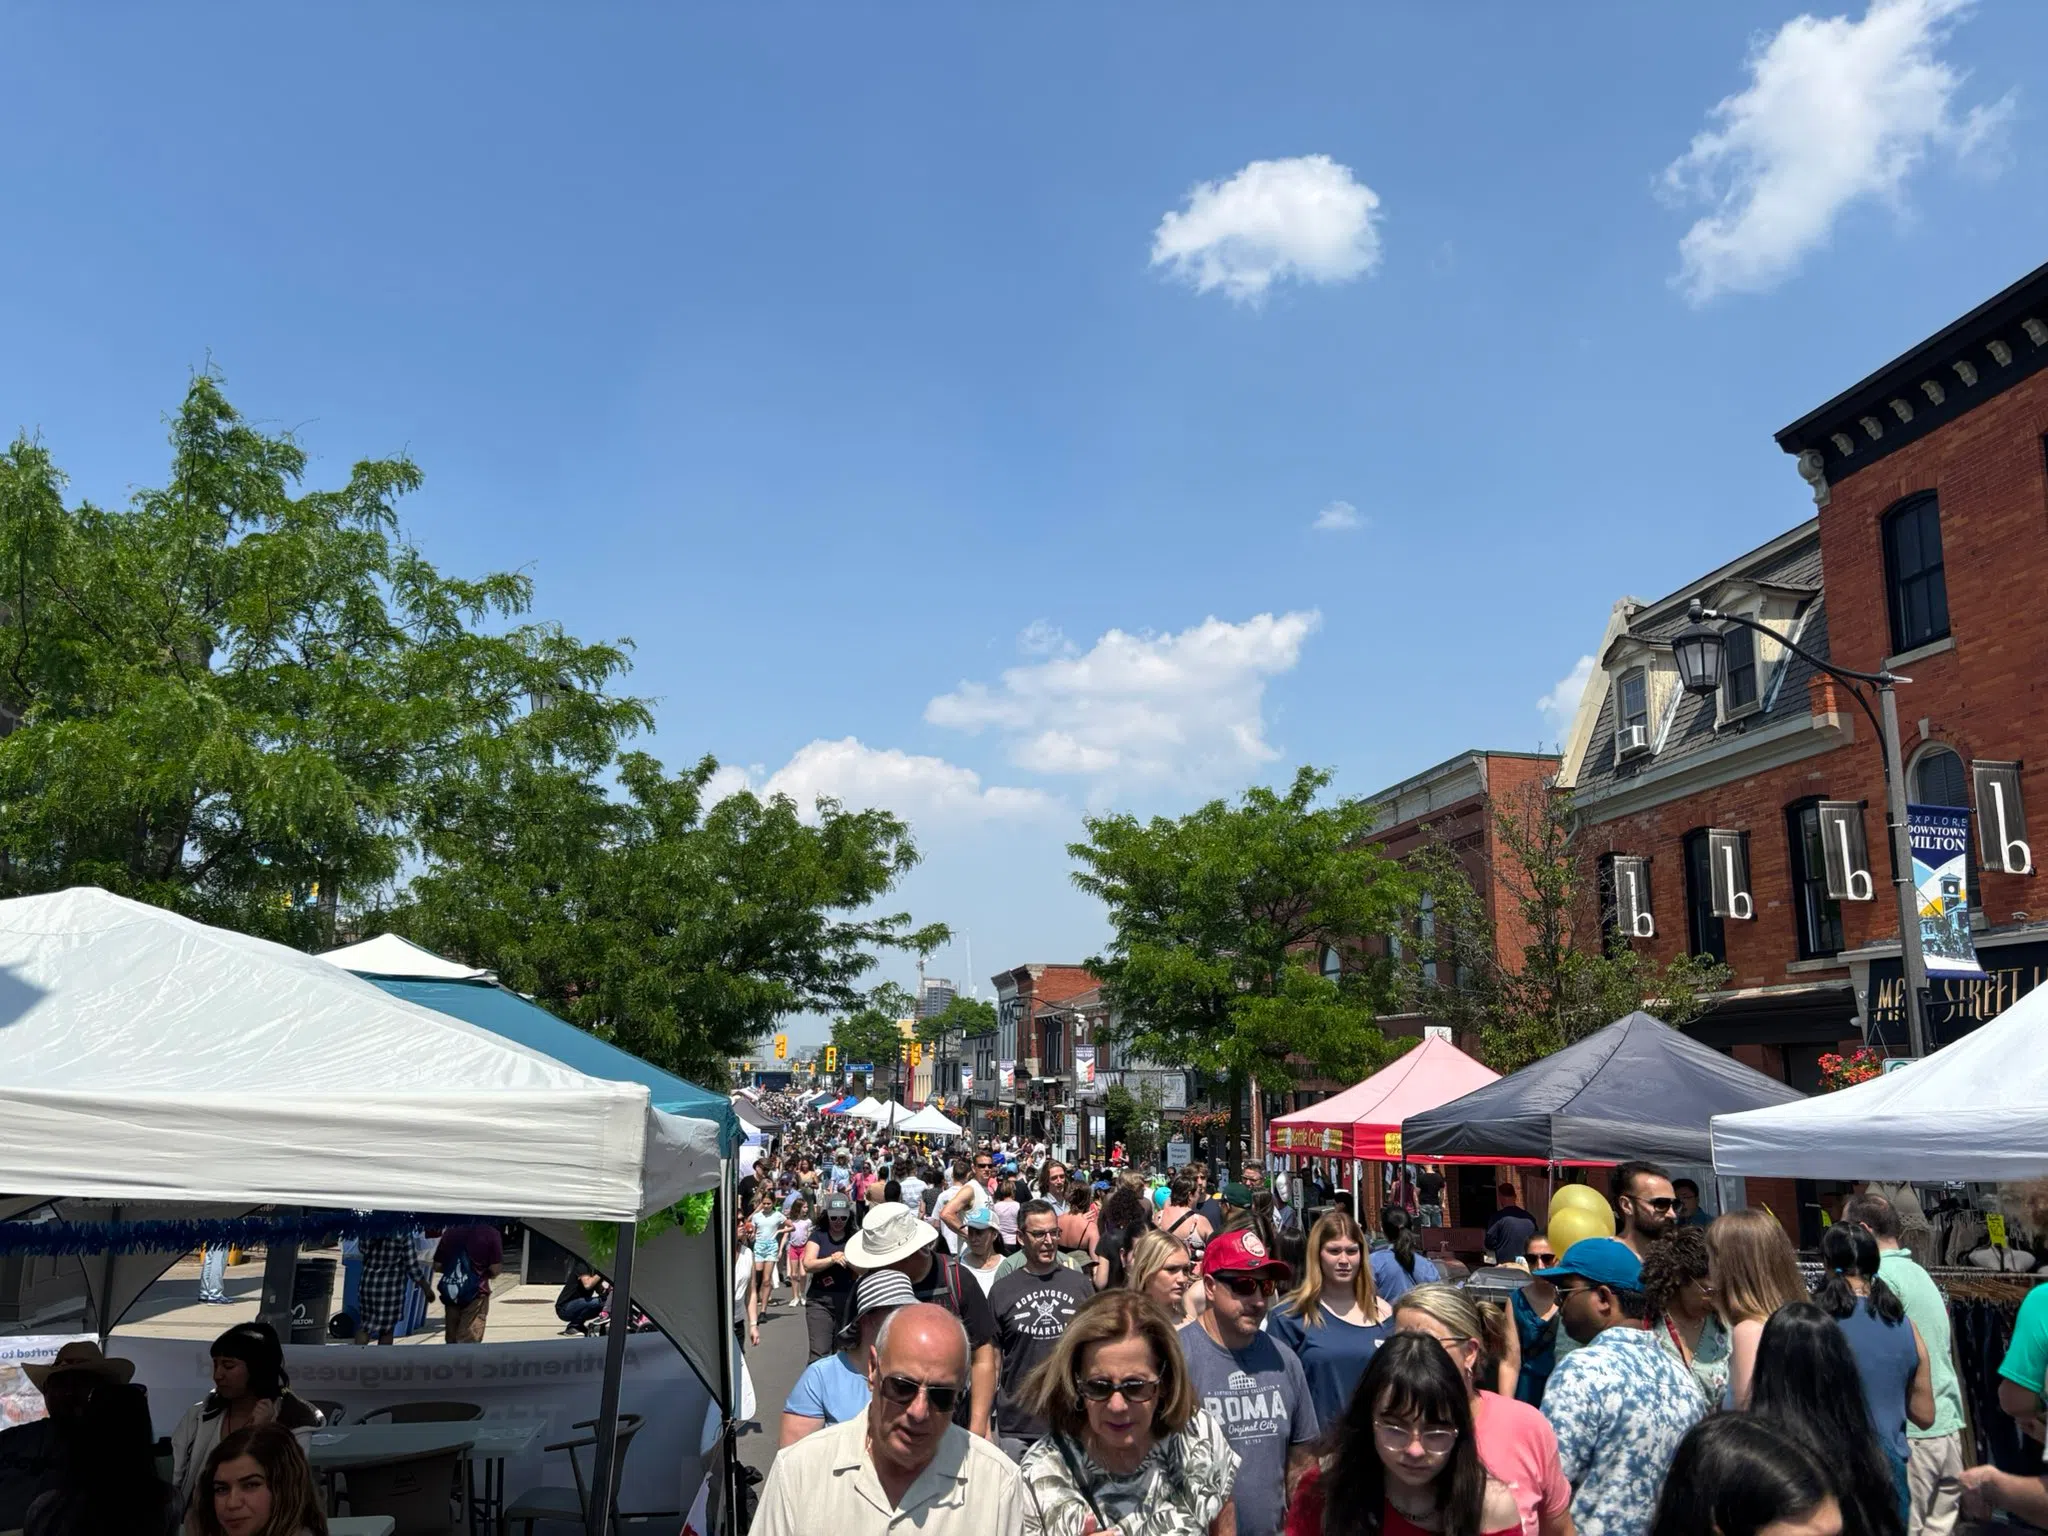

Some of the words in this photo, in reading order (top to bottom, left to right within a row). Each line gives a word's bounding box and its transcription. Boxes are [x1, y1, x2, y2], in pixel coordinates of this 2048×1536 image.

[1908, 814, 1968, 827] EXPLORE
[1990, 782, 2031, 874] b
[1908, 825, 1966, 837] DOWNTOWN
[1909, 835, 1966, 851] MILTON
[1835, 819, 1873, 900] b
[1722, 846, 1753, 919] b
[1626, 871, 1654, 937] b
[1943, 967, 2023, 1023] STREET
[1309, 1128, 1323, 1148] Corn
[1015, 1289, 1075, 1309] BOBCAYGEON
[1018, 1322, 1067, 1335] KAWARTH
[1203, 1390, 1288, 1425] ROMA
[1228, 1421, 1258, 1436] Original
[1260, 1419, 1278, 1433] City
